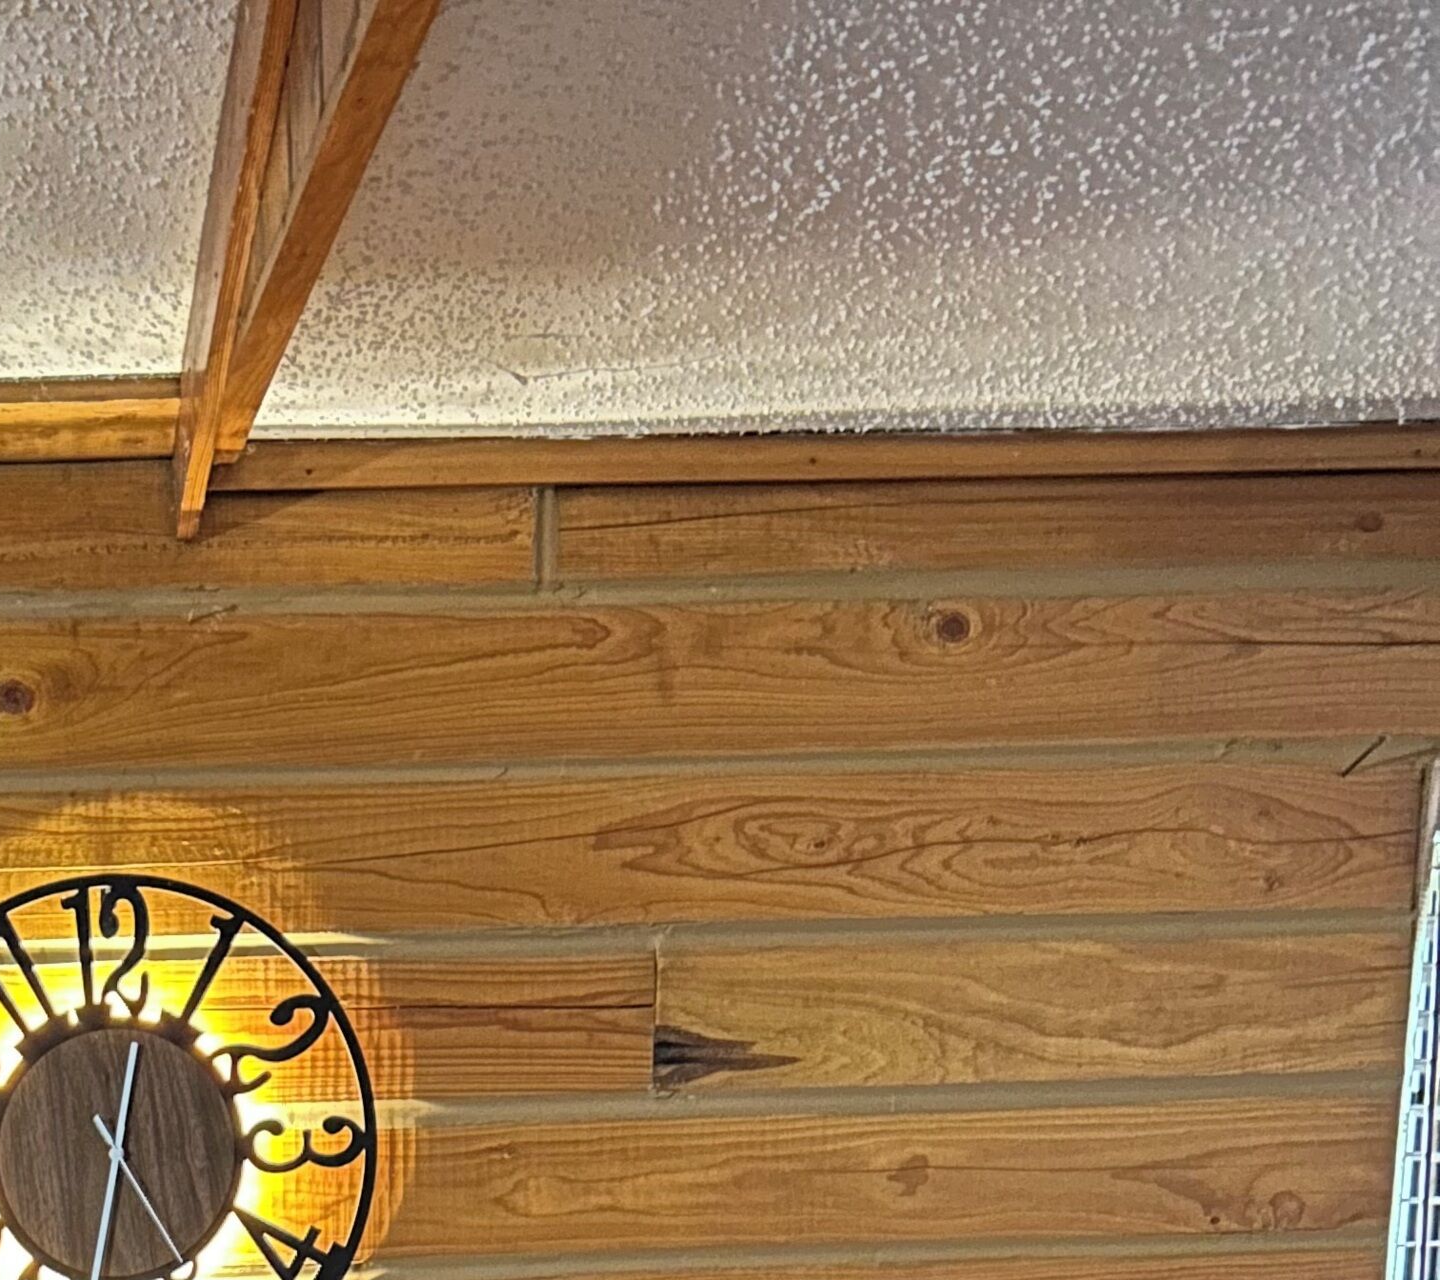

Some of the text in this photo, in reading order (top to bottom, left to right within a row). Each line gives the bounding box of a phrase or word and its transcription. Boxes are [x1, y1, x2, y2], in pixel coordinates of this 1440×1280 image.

[60, 885, 149, 1022] 12
[162, 913, 245, 1038] 1
[210, 994, 329, 1095] 2
[244, 1115, 365, 1174] 3
